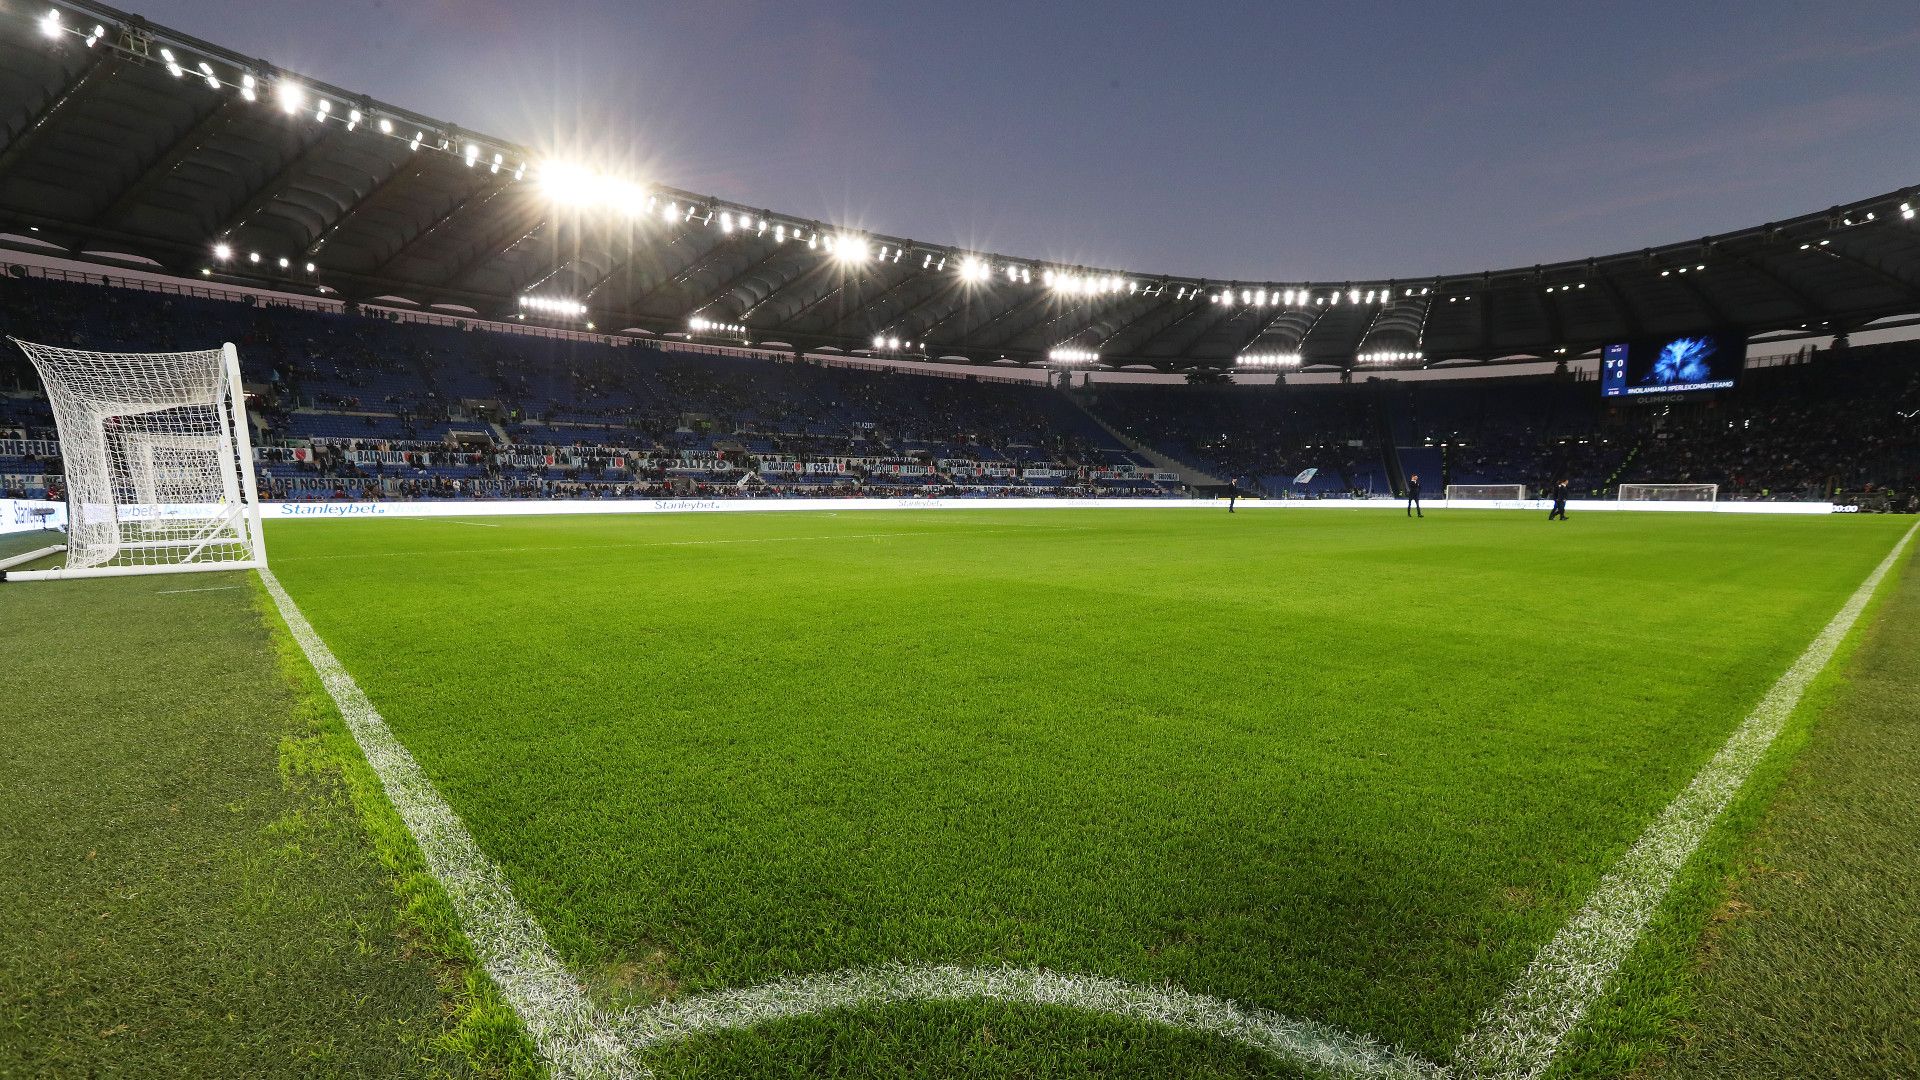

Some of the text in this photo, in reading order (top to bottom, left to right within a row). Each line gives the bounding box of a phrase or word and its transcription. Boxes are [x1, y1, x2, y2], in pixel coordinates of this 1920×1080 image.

[1617, 359, 1624, 367] 0
[1616, 370, 1623, 378] 0
[1637, 394, 1684, 404] OLIMPICO
[258, 448, 294, 461] ER
[358, 450, 404, 463] BALDUINA
[813, 463, 839, 472] OSTIA
